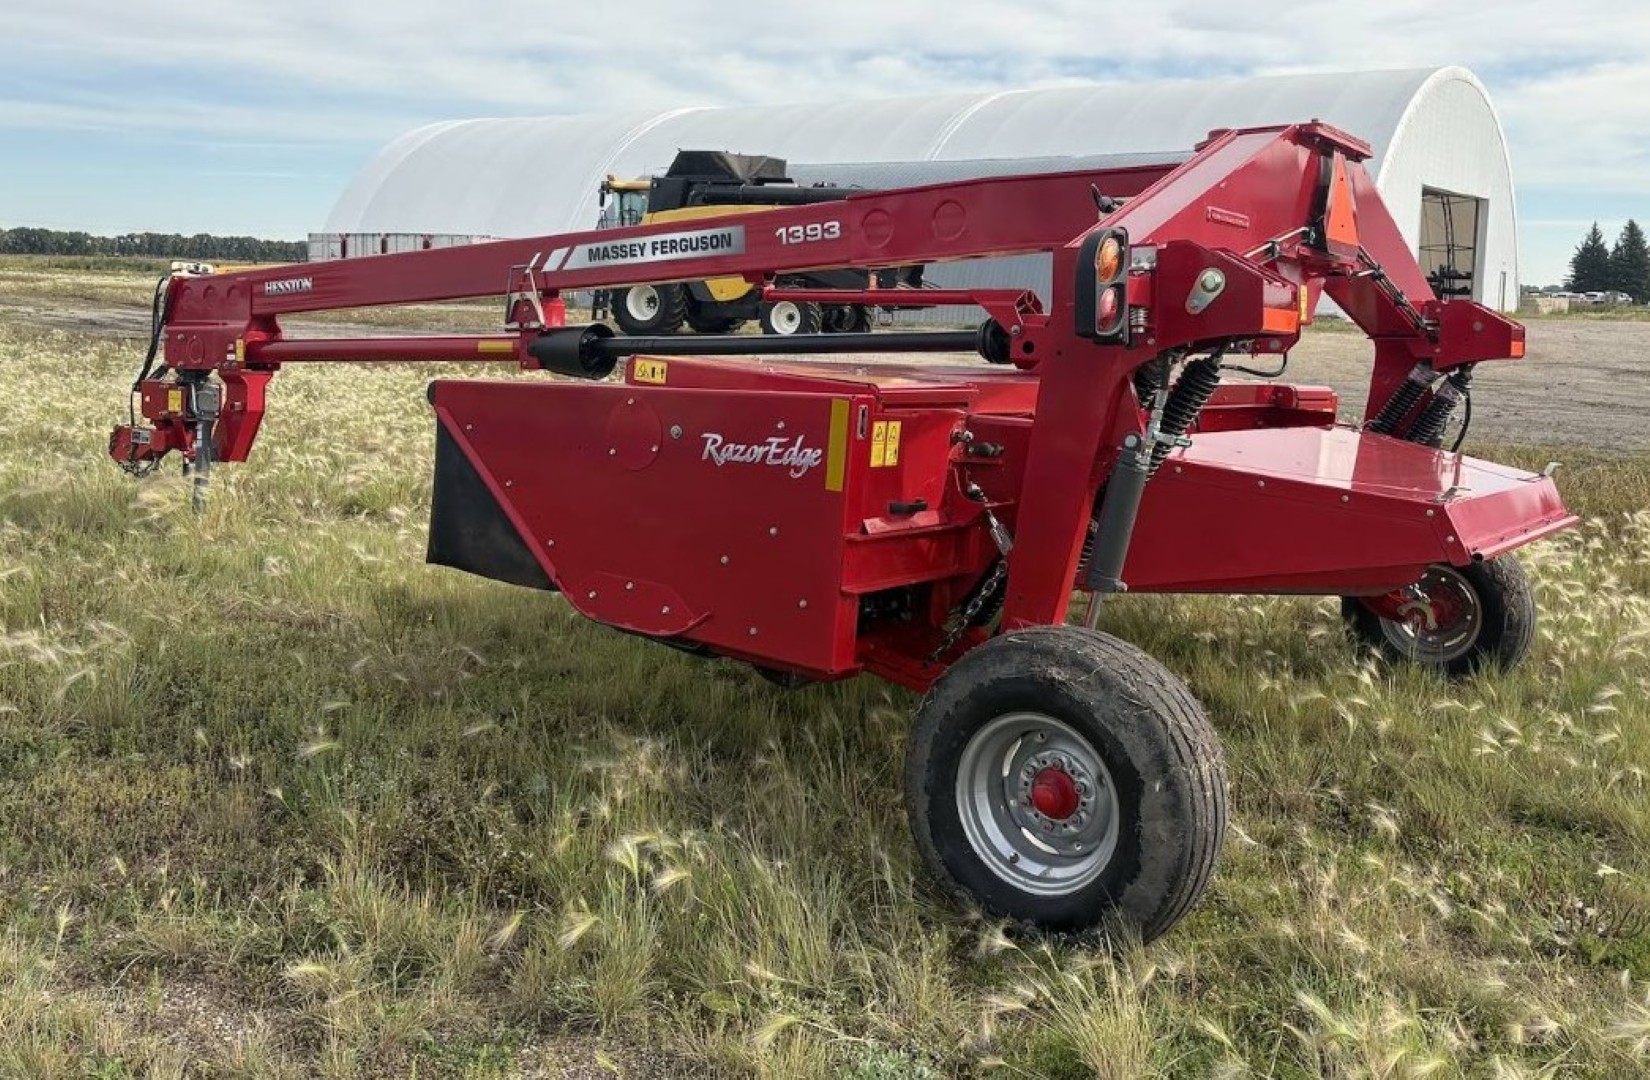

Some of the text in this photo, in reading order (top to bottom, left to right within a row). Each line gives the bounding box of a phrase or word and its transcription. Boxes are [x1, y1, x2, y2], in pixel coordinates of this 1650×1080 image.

[775, 221, 841, 245] 1393
[588, 233, 732, 262] MASSEY FERGUSON
[264, 277, 313, 295] HESSTON
[700, 433, 822, 478] RazorEdge
